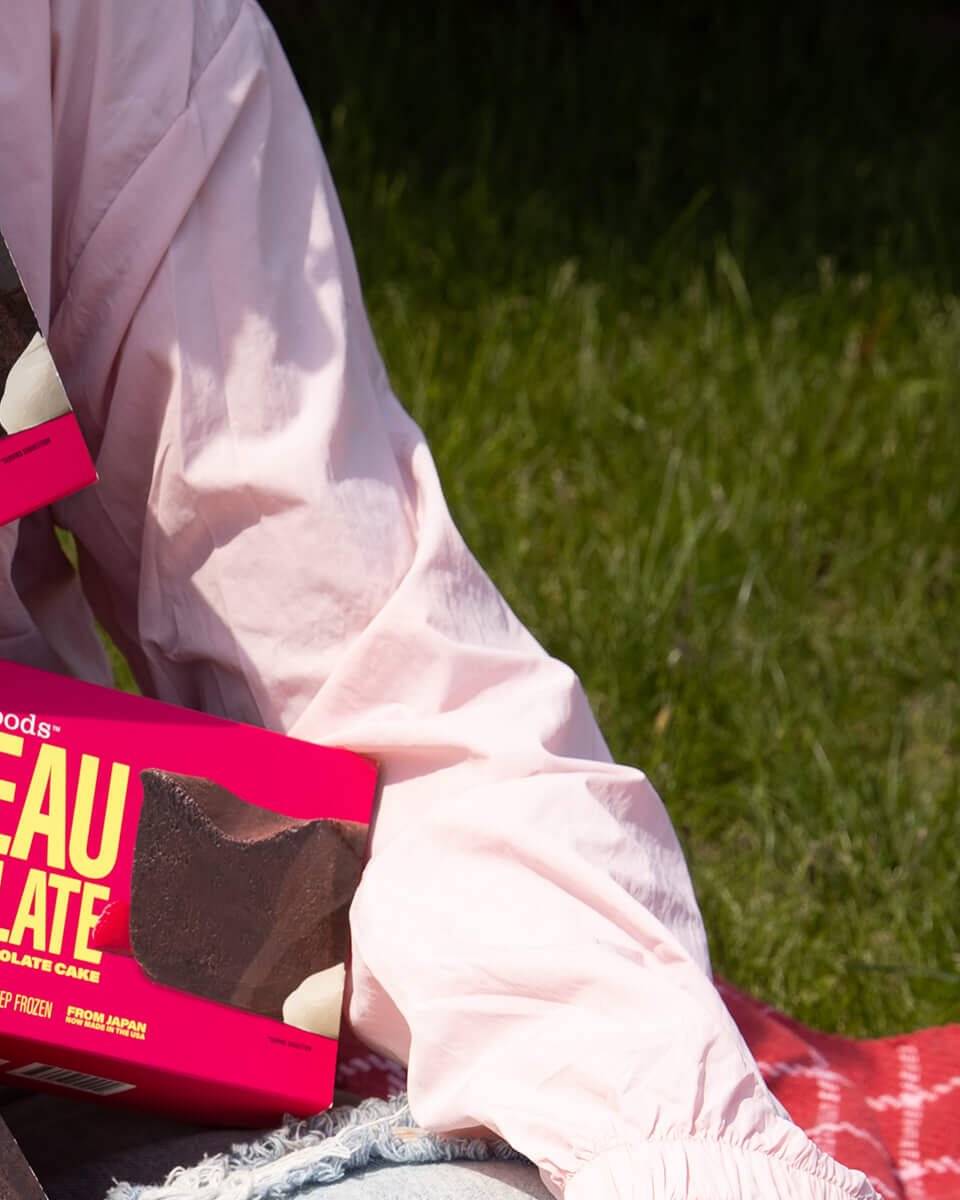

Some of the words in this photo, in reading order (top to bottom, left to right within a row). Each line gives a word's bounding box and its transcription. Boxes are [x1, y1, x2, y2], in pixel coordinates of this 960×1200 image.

[53, 962, 100, 983] CAKE
[13, 994, 52, 1018] FROZEN
[66, 1005, 104, 1023] FROM
[105, 1014, 146, 1033] JAPAN
